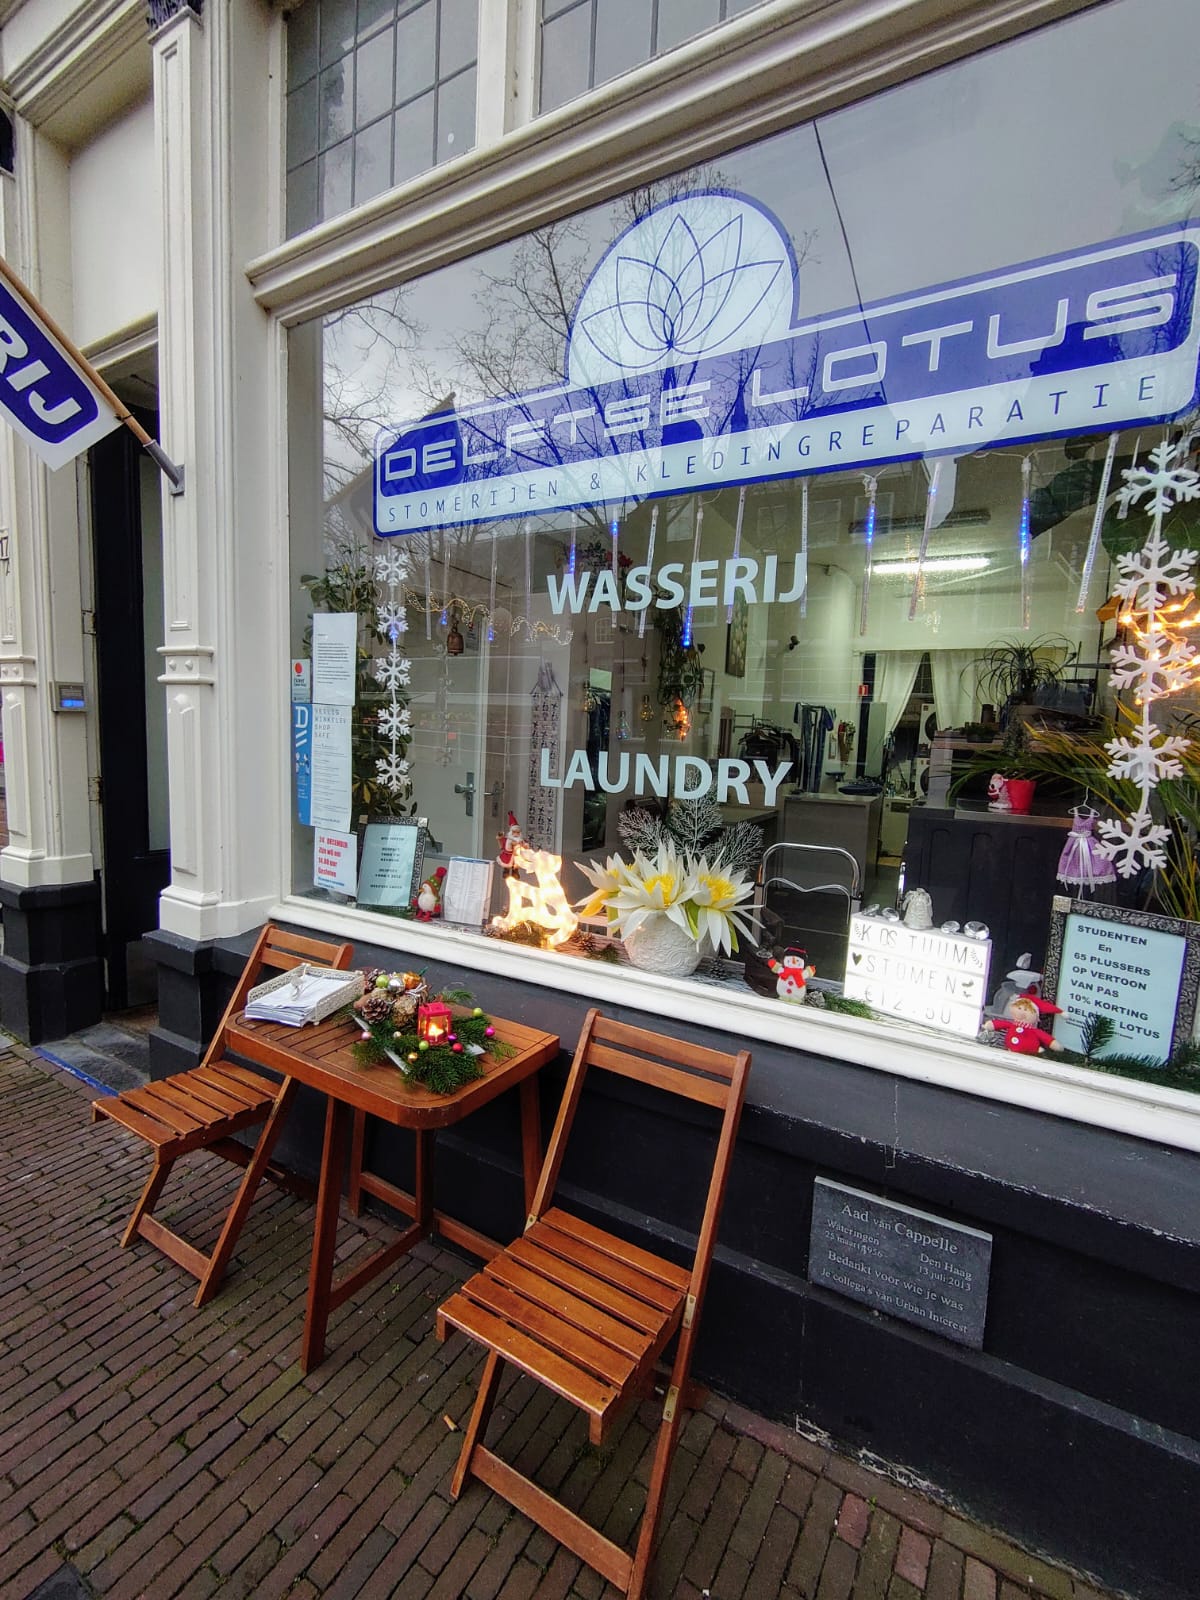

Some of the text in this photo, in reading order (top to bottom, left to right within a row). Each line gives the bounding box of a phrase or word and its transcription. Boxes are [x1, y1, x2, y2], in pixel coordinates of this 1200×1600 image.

[385, 274, 1177, 481] DELFTSE LOTUS
[389, 375, 1156, 522] STOMERIJEN & KLEDINGREPARATIE
[547, 553, 807, 615] WASSERIJ
[540, 748, 793, 807] LAUNDRY
[1077, 925, 1148, 946] STUDENTEN
[1098, 943, 1112, 953] En
[866, 955, 957, 994] STOMEN
[1072, 966, 1147, 991] OP VERTOON
[1074, 952, 1151, 977] 65 PLUSSERS
[1070, 979, 1120, 998] VAN PAS
[1069, 992, 1149, 1021] 10% KORTING
[1067, 1005, 1116, 1025] DELE
[1119, 1021, 1160, 1039] LOTUS
[825, 1230, 835, 1240] 25
[837, 1236, 860, 1249] maart
[827, 1219, 880, 1245] Wateringen
[841, 1204, 958, 1254] Aad van Cappelle
[828, 1250, 964, 1311] Bedankt voor wie je was
[919, 1266, 971, 1291] 13 juli 2013
[920, 1253, 972, 1281] Den Haag
[833, 1274, 873, 1295] collega's
[875, 1291, 893, 1303] van
[896, 1297, 926, 1317] Urban
[929, 1310, 968, 1333] Interest
